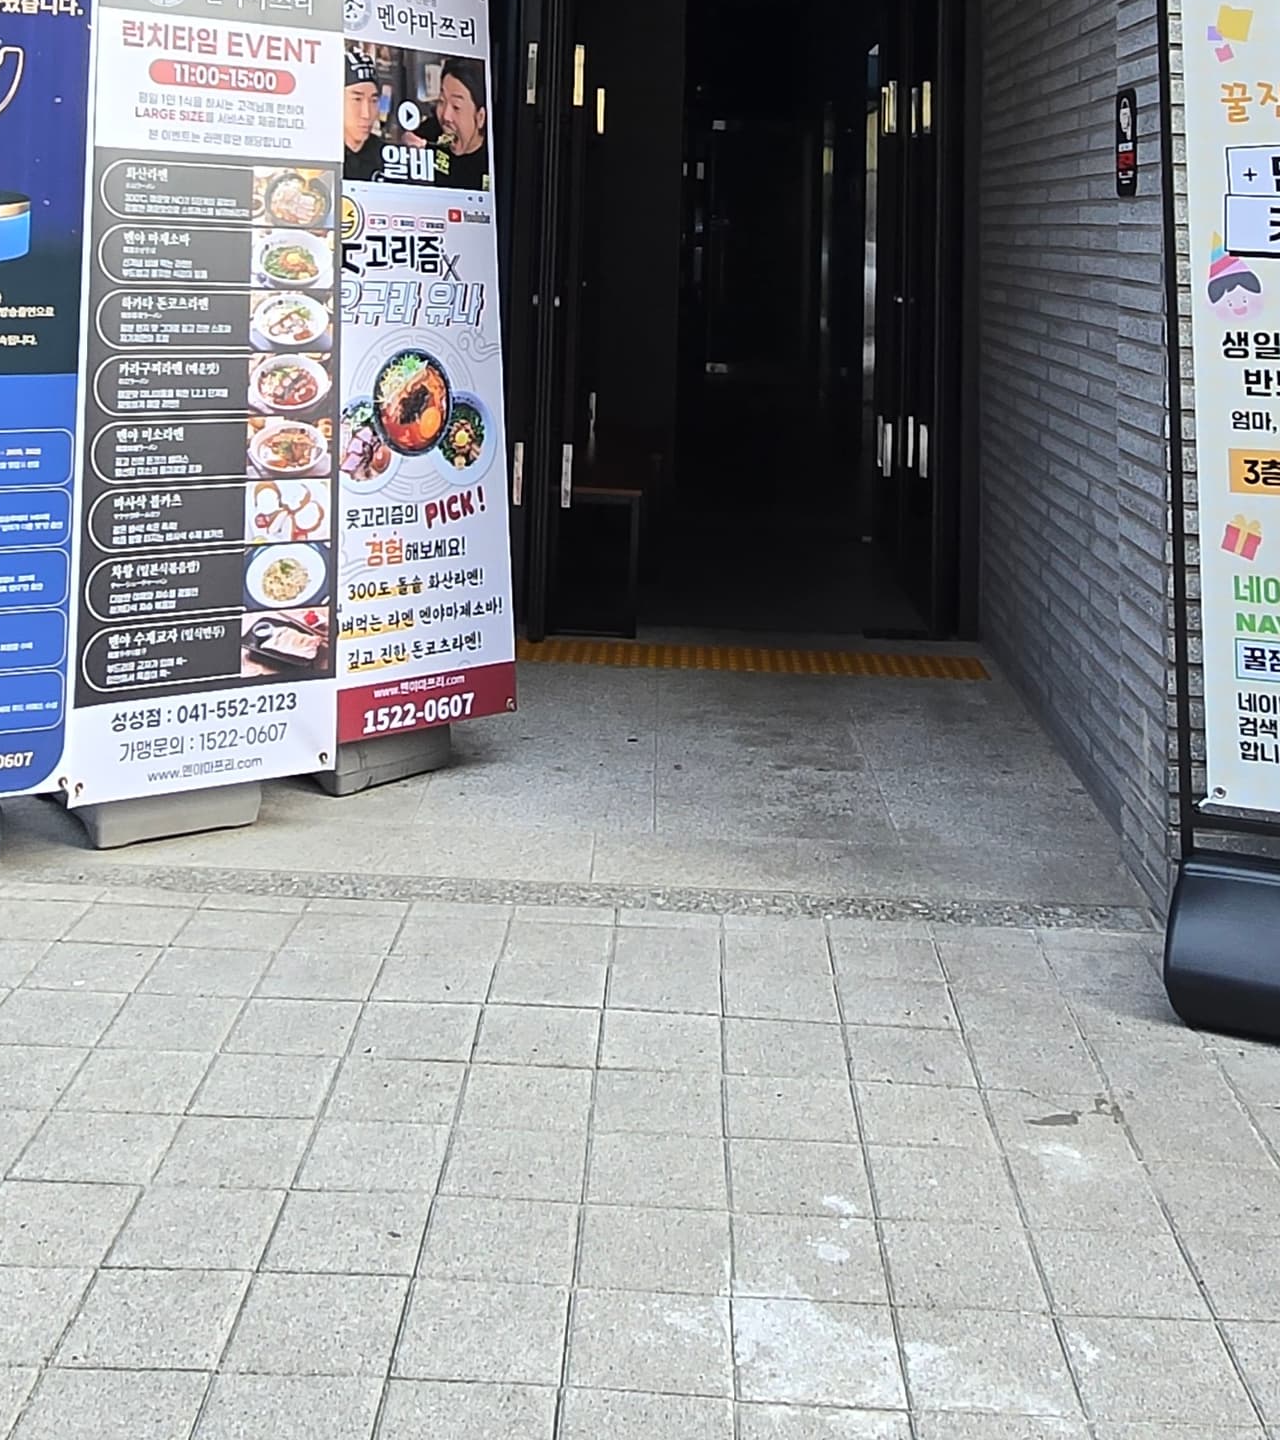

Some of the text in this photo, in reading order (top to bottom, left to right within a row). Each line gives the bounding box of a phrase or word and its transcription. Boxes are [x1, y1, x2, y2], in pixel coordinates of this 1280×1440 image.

[123, 20, 321, 64] 런치타임 EVENT
[377, 4, 476, 45] 멘야마쯔리
[174, 62, 276, 90] 11:00~15:00
[135, 107, 176, 121] LARGE
[382, 145, 438, 182] 알바
[1231, 411, 1277, 434] 엄마,
[346, 503, 419, 530] 웃고리즘의
[347, 579, 392, 601] 300도
[427, 568, 484, 590] 화산라멘!
[387, 610, 414, 628] 라멘
[347, 631, 483, 669] 깊고 진한 돈코츠라멘!
[111, 708, 162, 732] 성성점
[177, 692, 297, 724] 041-552-2123
[362, 692, 475, 734] 1522-0607
[1239, 717, 1278, 739] 검색
[119, 736, 184, 761] 가맹문의
[199, 722, 288, 751] 1522-0607
